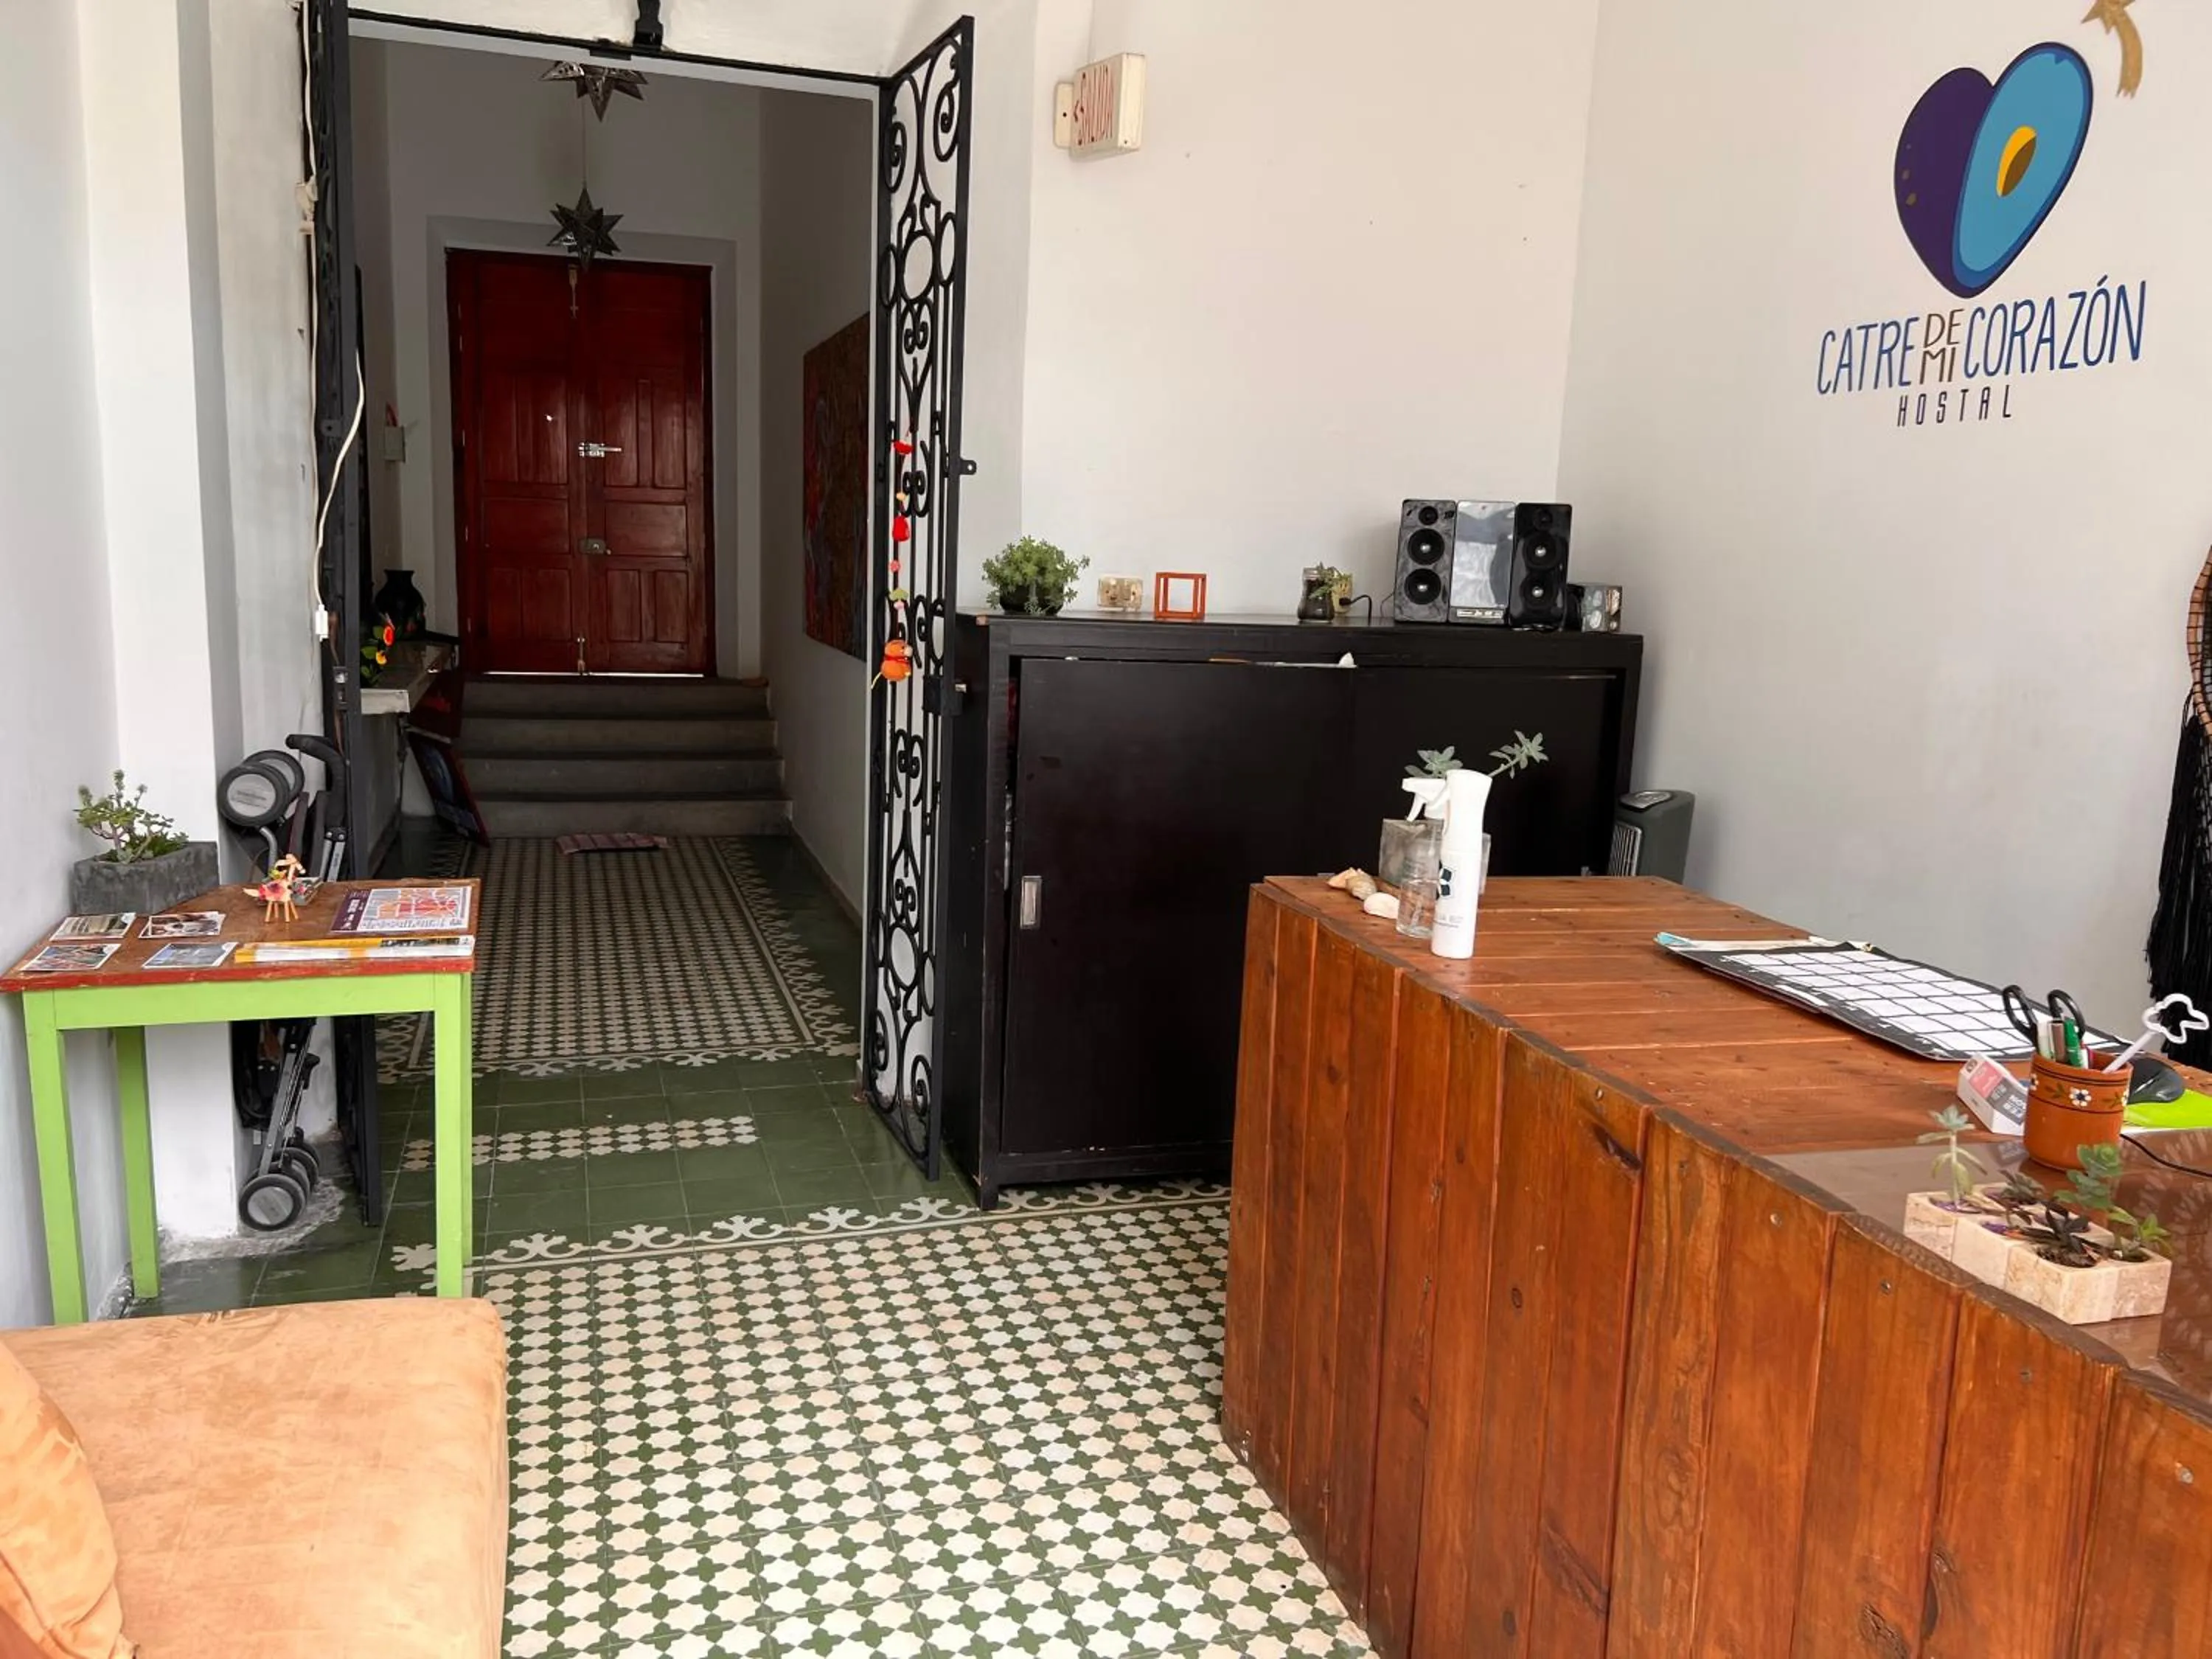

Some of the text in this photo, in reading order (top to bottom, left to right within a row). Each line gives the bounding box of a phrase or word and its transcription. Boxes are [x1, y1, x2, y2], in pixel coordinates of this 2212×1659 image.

[1923, 308, 1965, 349] DE
[1964, 274, 2146, 379] CORAZÓN
[1817, 316, 1920, 395] CATRE
[1919, 347, 1957, 385] MI
[1896, 384, 2012, 428] HOSTAL
